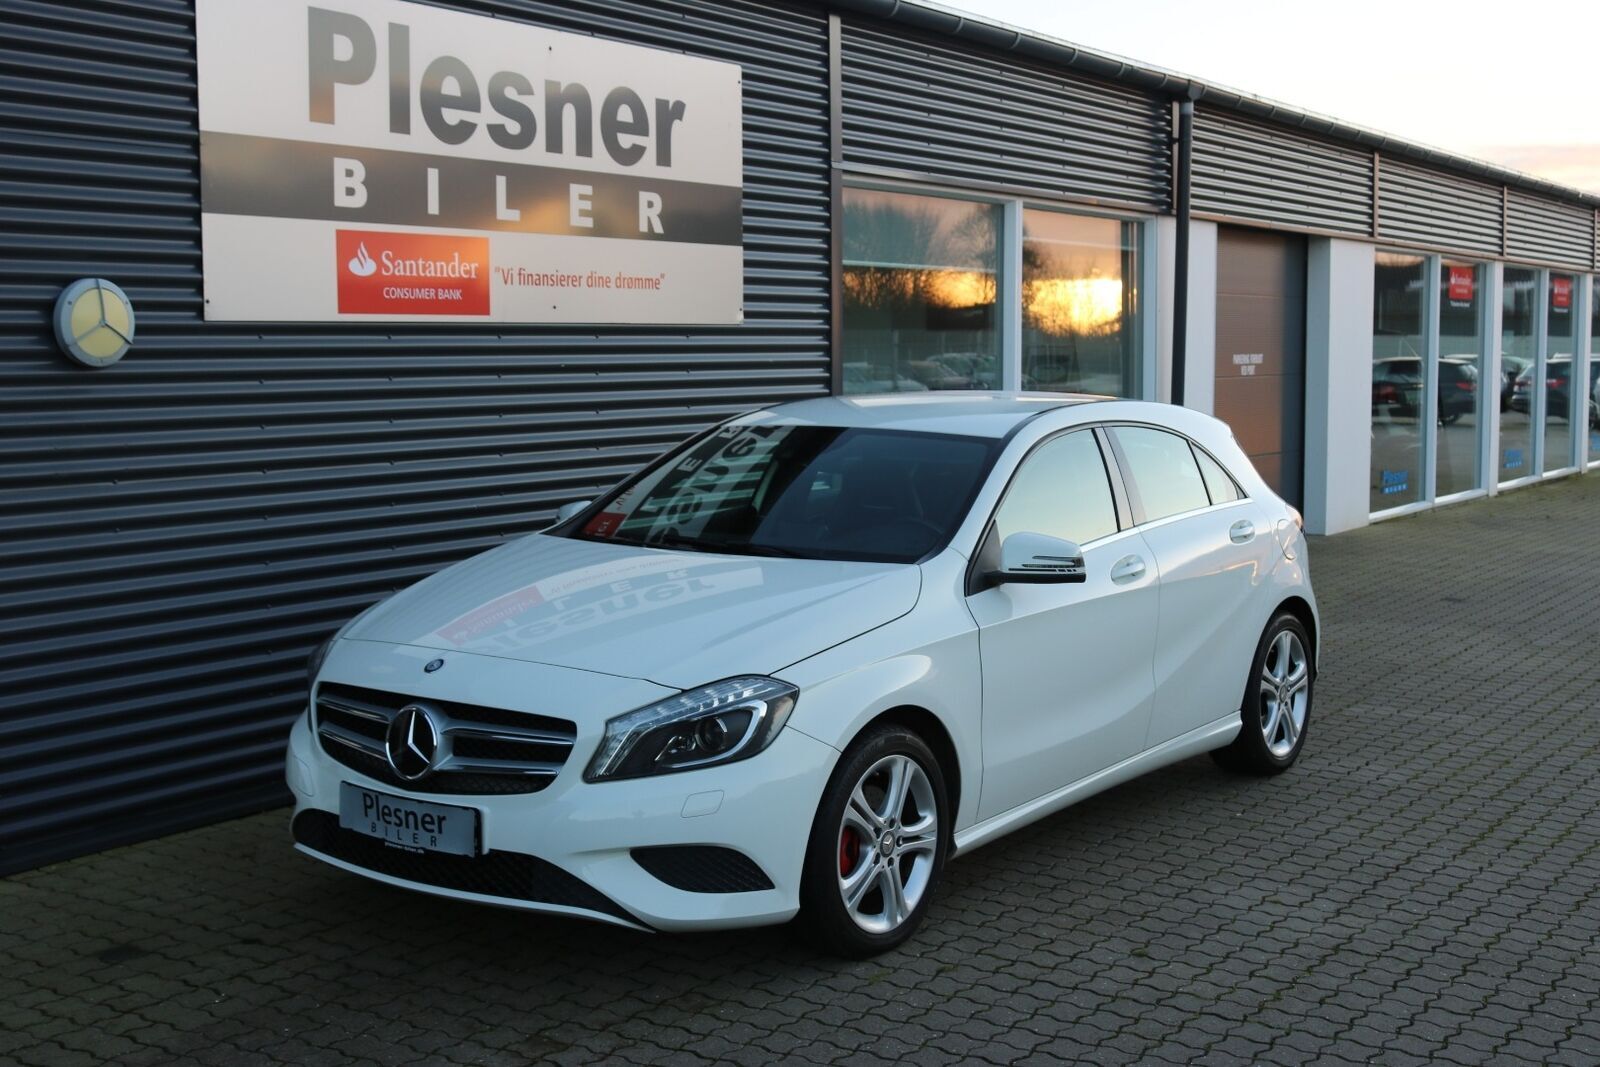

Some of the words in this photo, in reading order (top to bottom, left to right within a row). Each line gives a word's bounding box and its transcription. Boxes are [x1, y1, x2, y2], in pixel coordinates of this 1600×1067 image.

[308, 6, 686, 168] Plesner
[333, 157, 664, 234] BILER
[381, 250, 479, 279] Santander
[517, 268, 583, 288] finansierer
[586, 270, 611, 288] dine
[383, 287, 436, 299] CONSUMER
[438, 289, 463, 300] BANK
[362, 792, 447, 834] Plesner
[370, 822, 437, 847] BILER
